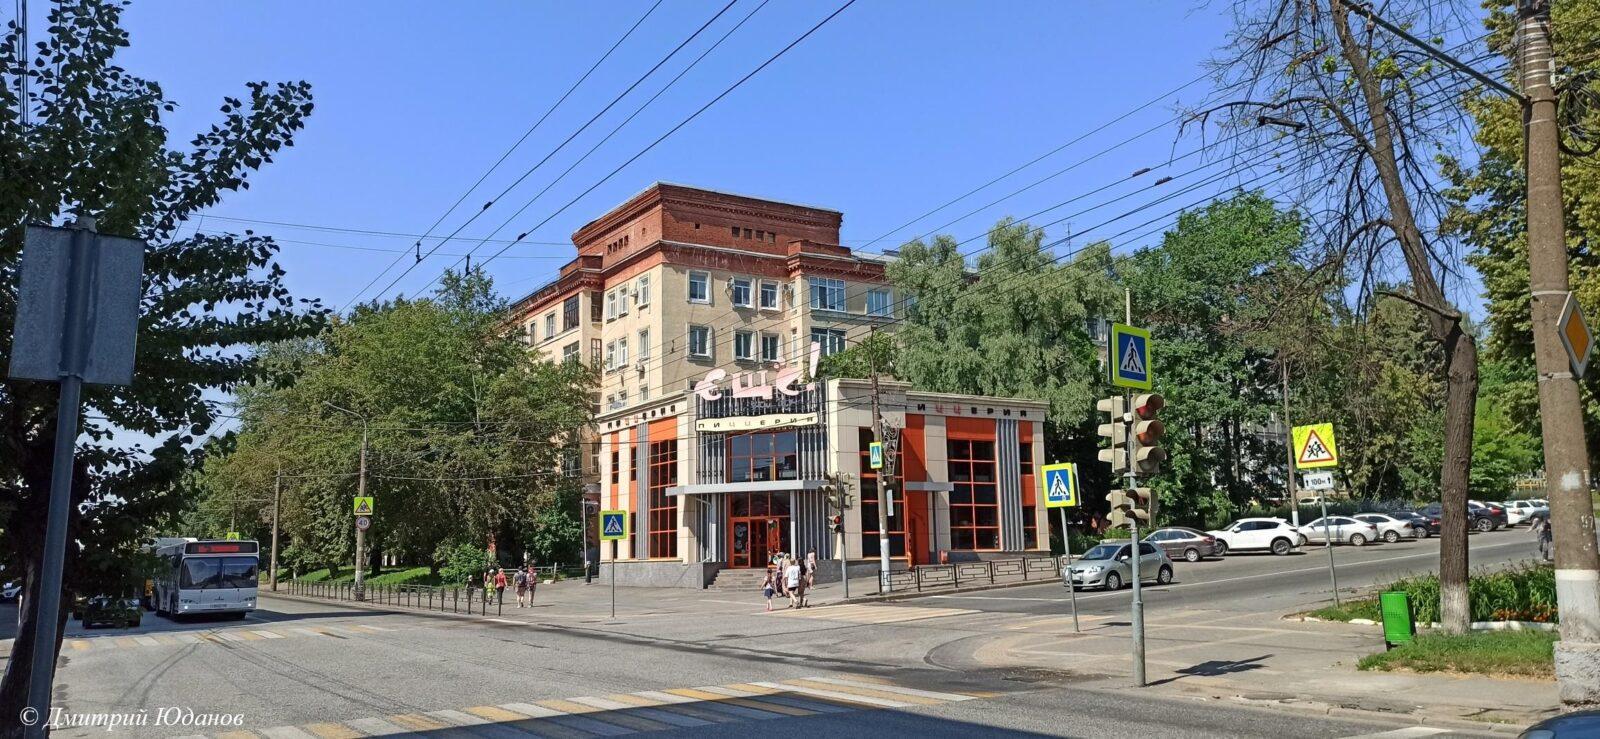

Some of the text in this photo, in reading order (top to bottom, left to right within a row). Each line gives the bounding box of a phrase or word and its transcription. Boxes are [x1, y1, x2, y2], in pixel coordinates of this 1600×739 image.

[607, 404, 676, 430] ПИЦЦЕРИЯ
[904, 403, 1027, 417] ИЦЦЕРИЯ
[698, 416, 813, 429] ПИЦЦЕРИЯ
